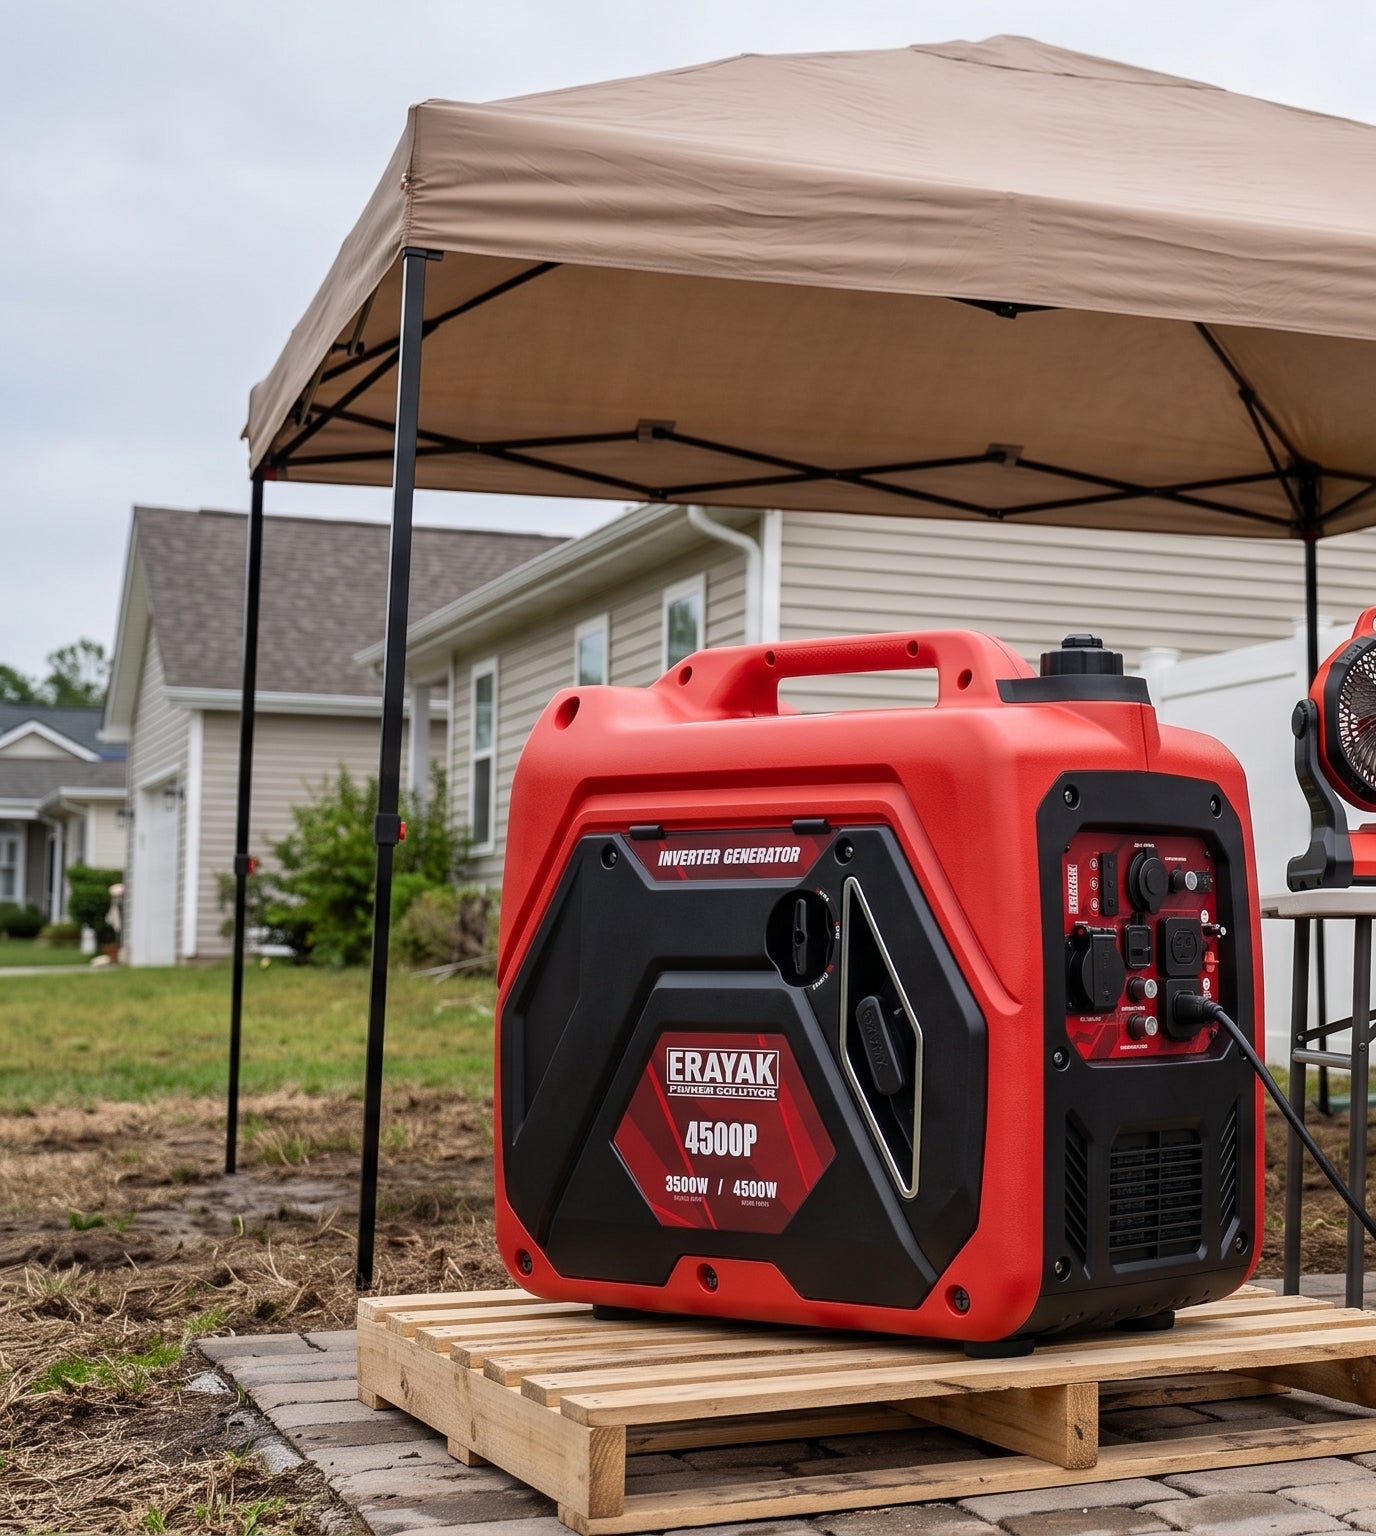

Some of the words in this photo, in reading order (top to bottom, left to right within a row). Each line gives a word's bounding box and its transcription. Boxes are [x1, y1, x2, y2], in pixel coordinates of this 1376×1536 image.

[657, 849, 721, 867] INVERTER
[723, 846, 801, 865] GENERATOR
[669, 1051, 775, 1085] ERAYAK
[684, 1121, 758, 1157] 4500P
[665, 1175, 709, 1195] 3500W
[732, 1180, 778, 1199] 4500W
